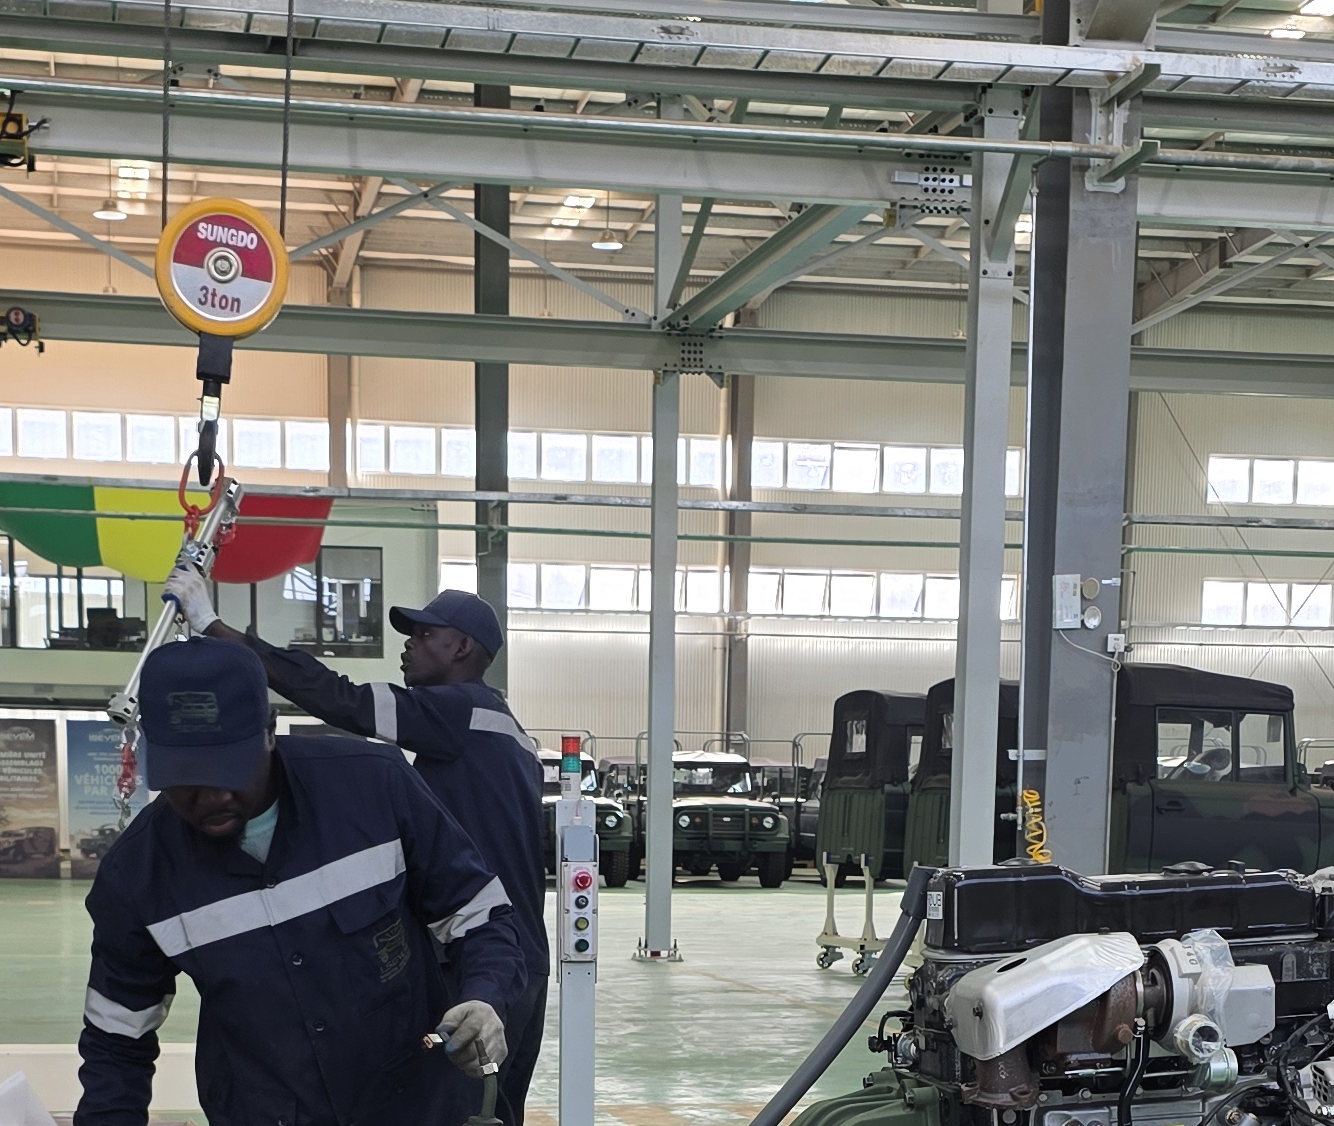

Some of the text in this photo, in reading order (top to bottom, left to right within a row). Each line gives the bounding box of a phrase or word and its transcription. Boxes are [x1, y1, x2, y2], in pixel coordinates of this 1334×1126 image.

[196, 221, 258, 250] SUNGDO
[197, 285, 242, 314] 3ton
[84, 785, 108, 796] PAR
